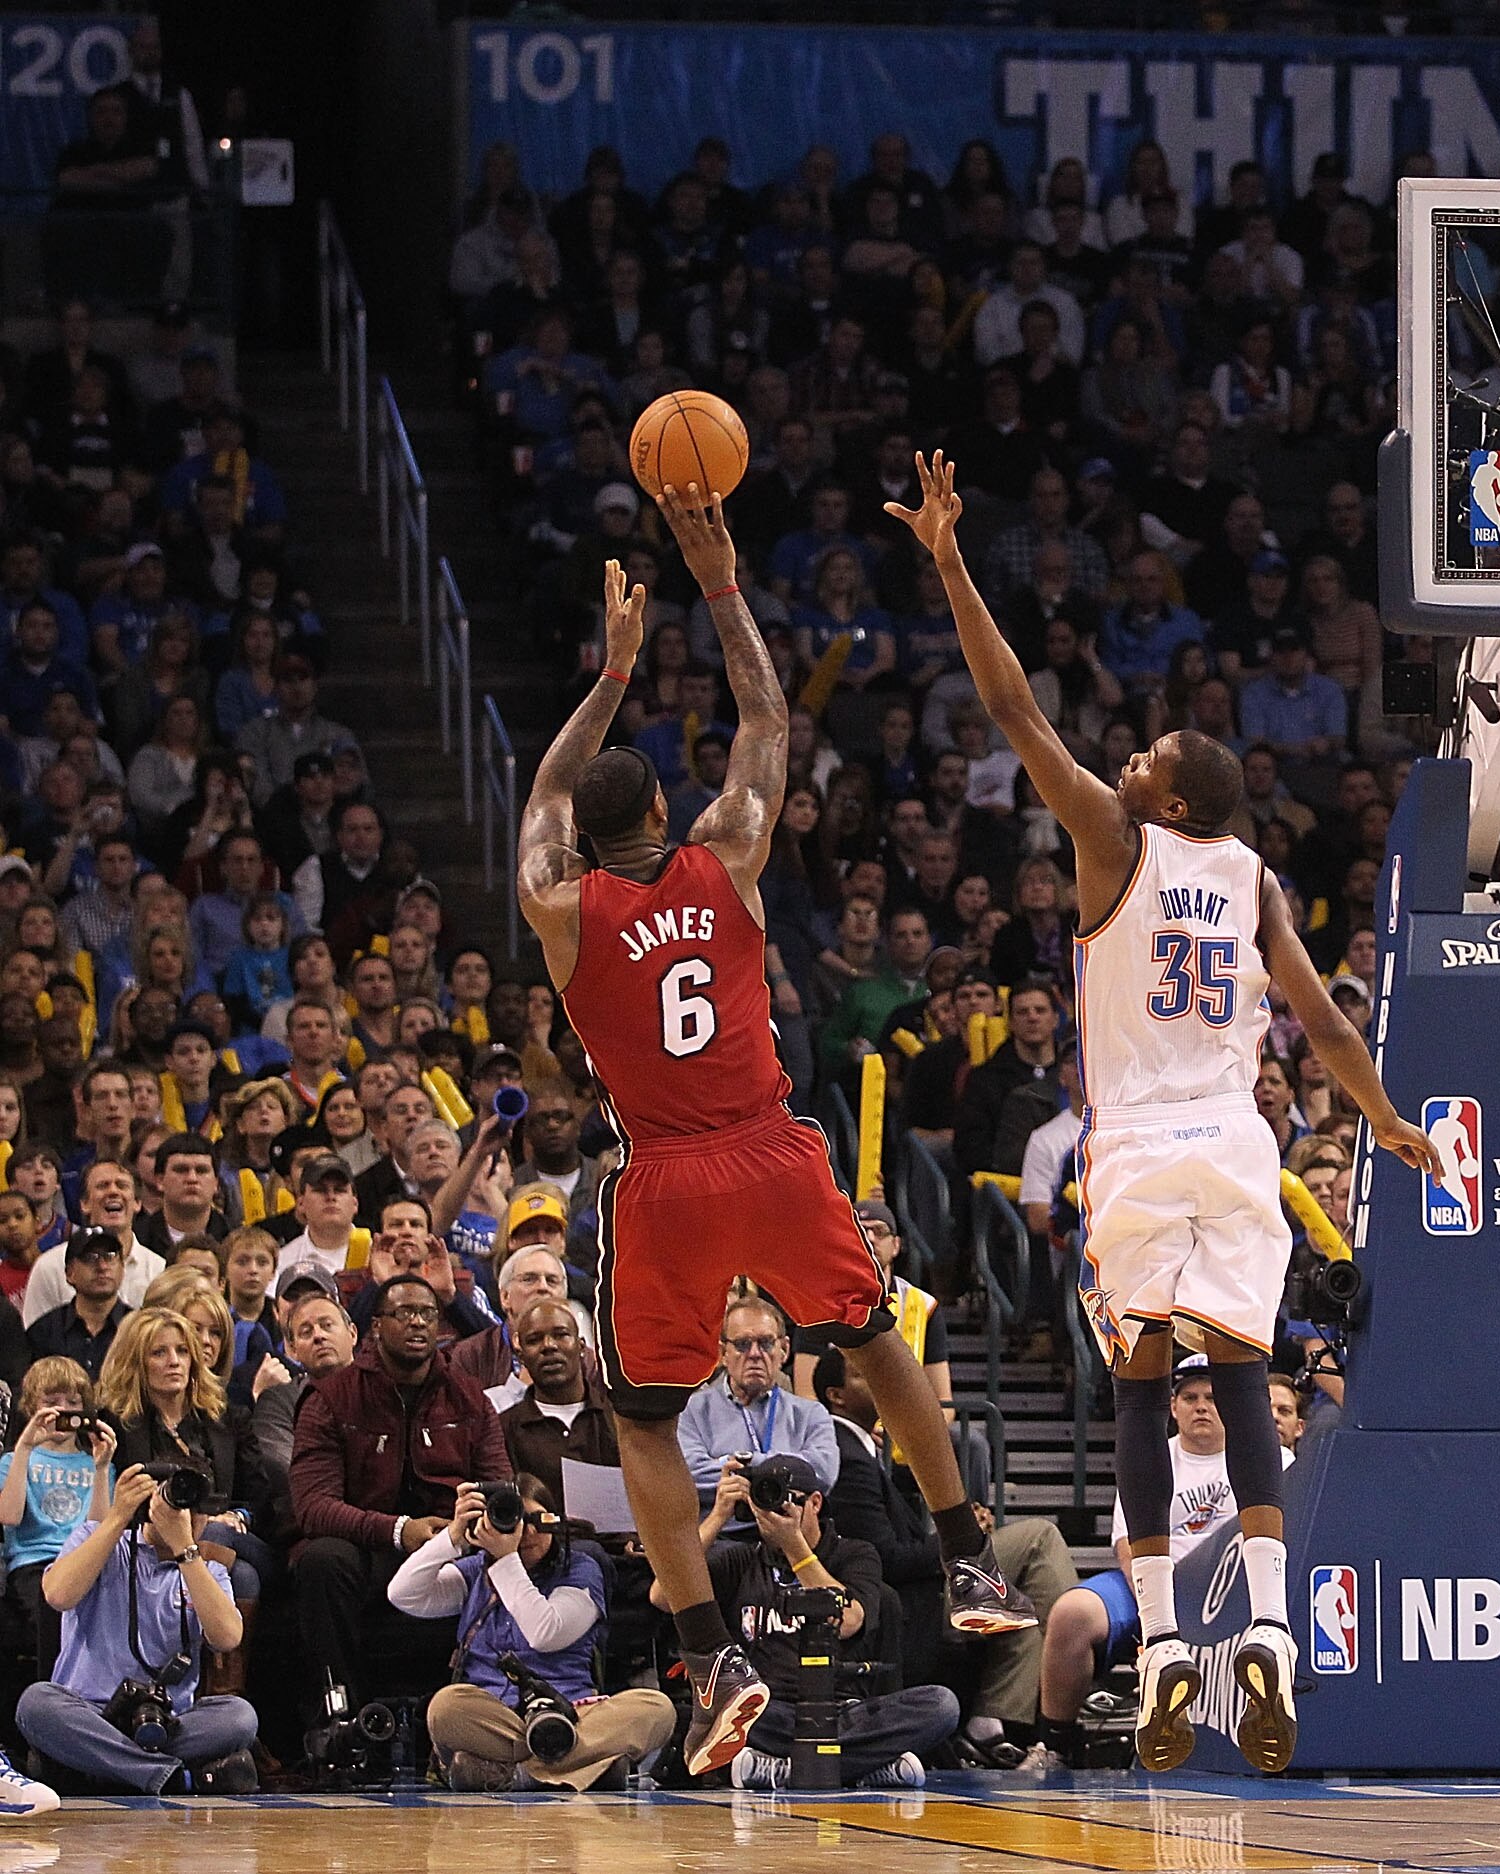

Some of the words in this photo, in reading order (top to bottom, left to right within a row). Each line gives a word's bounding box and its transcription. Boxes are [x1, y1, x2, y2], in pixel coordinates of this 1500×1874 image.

[475, 31, 615, 104] 101
[1474, 527, 1499, 542] NBA
[1158, 887, 1229, 927] DURANT
[619, 906, 716, 962] JAMES
[1147, 929, 1239, 1030] 35
[660, 957, 717, 1058] 6
[1430, 1206, 1464, 1226] NBA
[1316, 1651, 1344, 1668] NBA
